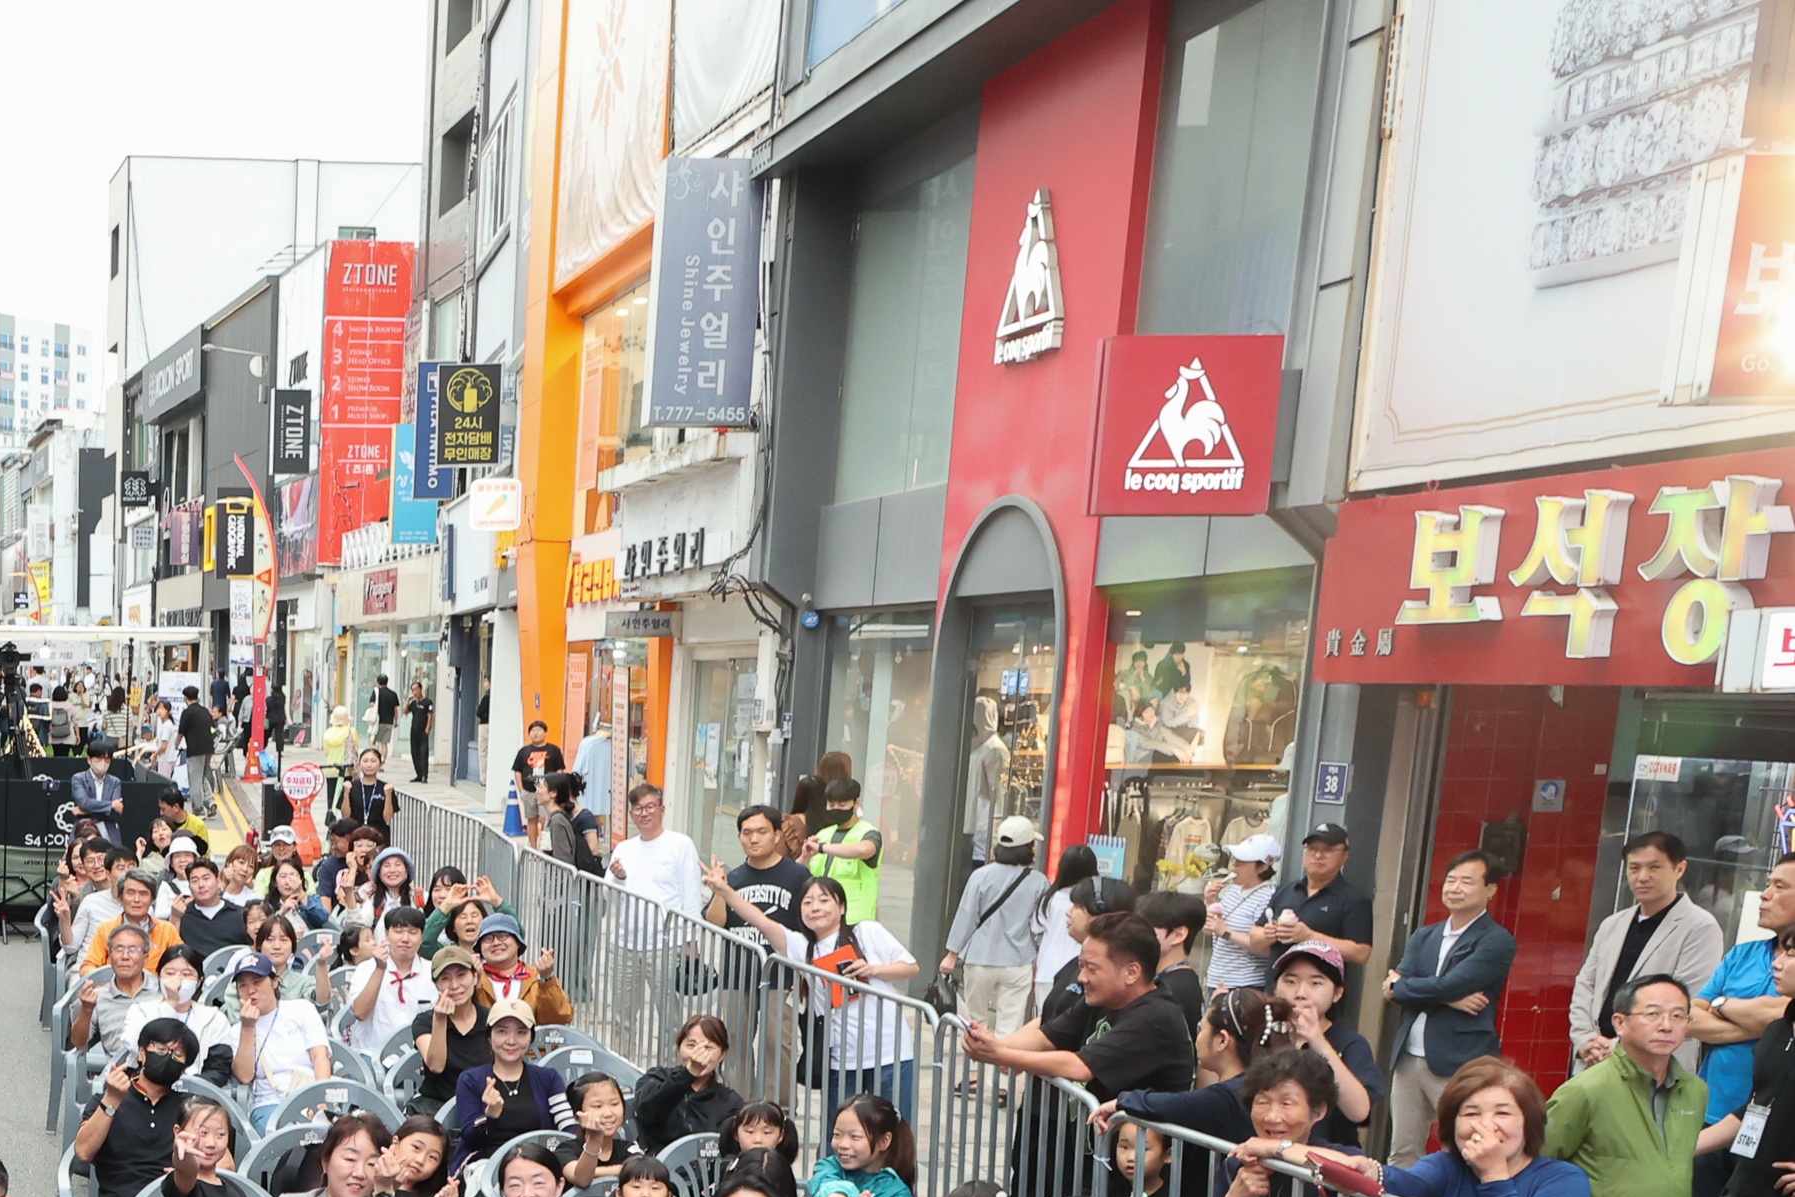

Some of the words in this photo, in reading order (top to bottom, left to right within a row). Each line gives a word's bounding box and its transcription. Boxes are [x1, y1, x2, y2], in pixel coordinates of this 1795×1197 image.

[342, 263, 398, 286] ZTONE
[681, 255, 700, 312] Shine
[697, 170, 745, 396] 샤인주얼리
[332, 321, 343, 337] 4
[1022, 322, 1055, 359] sportif
[333, 349, 343, 365] 3
[674, 317, 695, 395] Jewelry
[331, 375, 342, 391] 2
[331, 405, 339, 420] 1
[654, 406, 745, 422] T.777-5455
[285, 404, 304, 459] ZTONE
[454, 416, 483, 430] 24시
[444, 431, 493, 446] 전자담배
[347, 444, 380, 459] ZTONE
[444, 447, 492, 462] 무인매장
[1124, 469, 1141, 491] le
[1143, 472, 1179, 493] coq
[1179, 469, 1245, 492] sportif
[227, 515, 236, 569] GEOGRAPHIC
[237, 515, 246, 558] NATIONAL
[1394, 475, 1795, 664] 보석장
[1323, 628, 1395, 659] 貴金屬
[286, 777, 312, 785] 주차금지
[1324, 775, 1339, 793] 38
[25, 833, 41, 847] S4
[781, 889, 792, 910] OF
